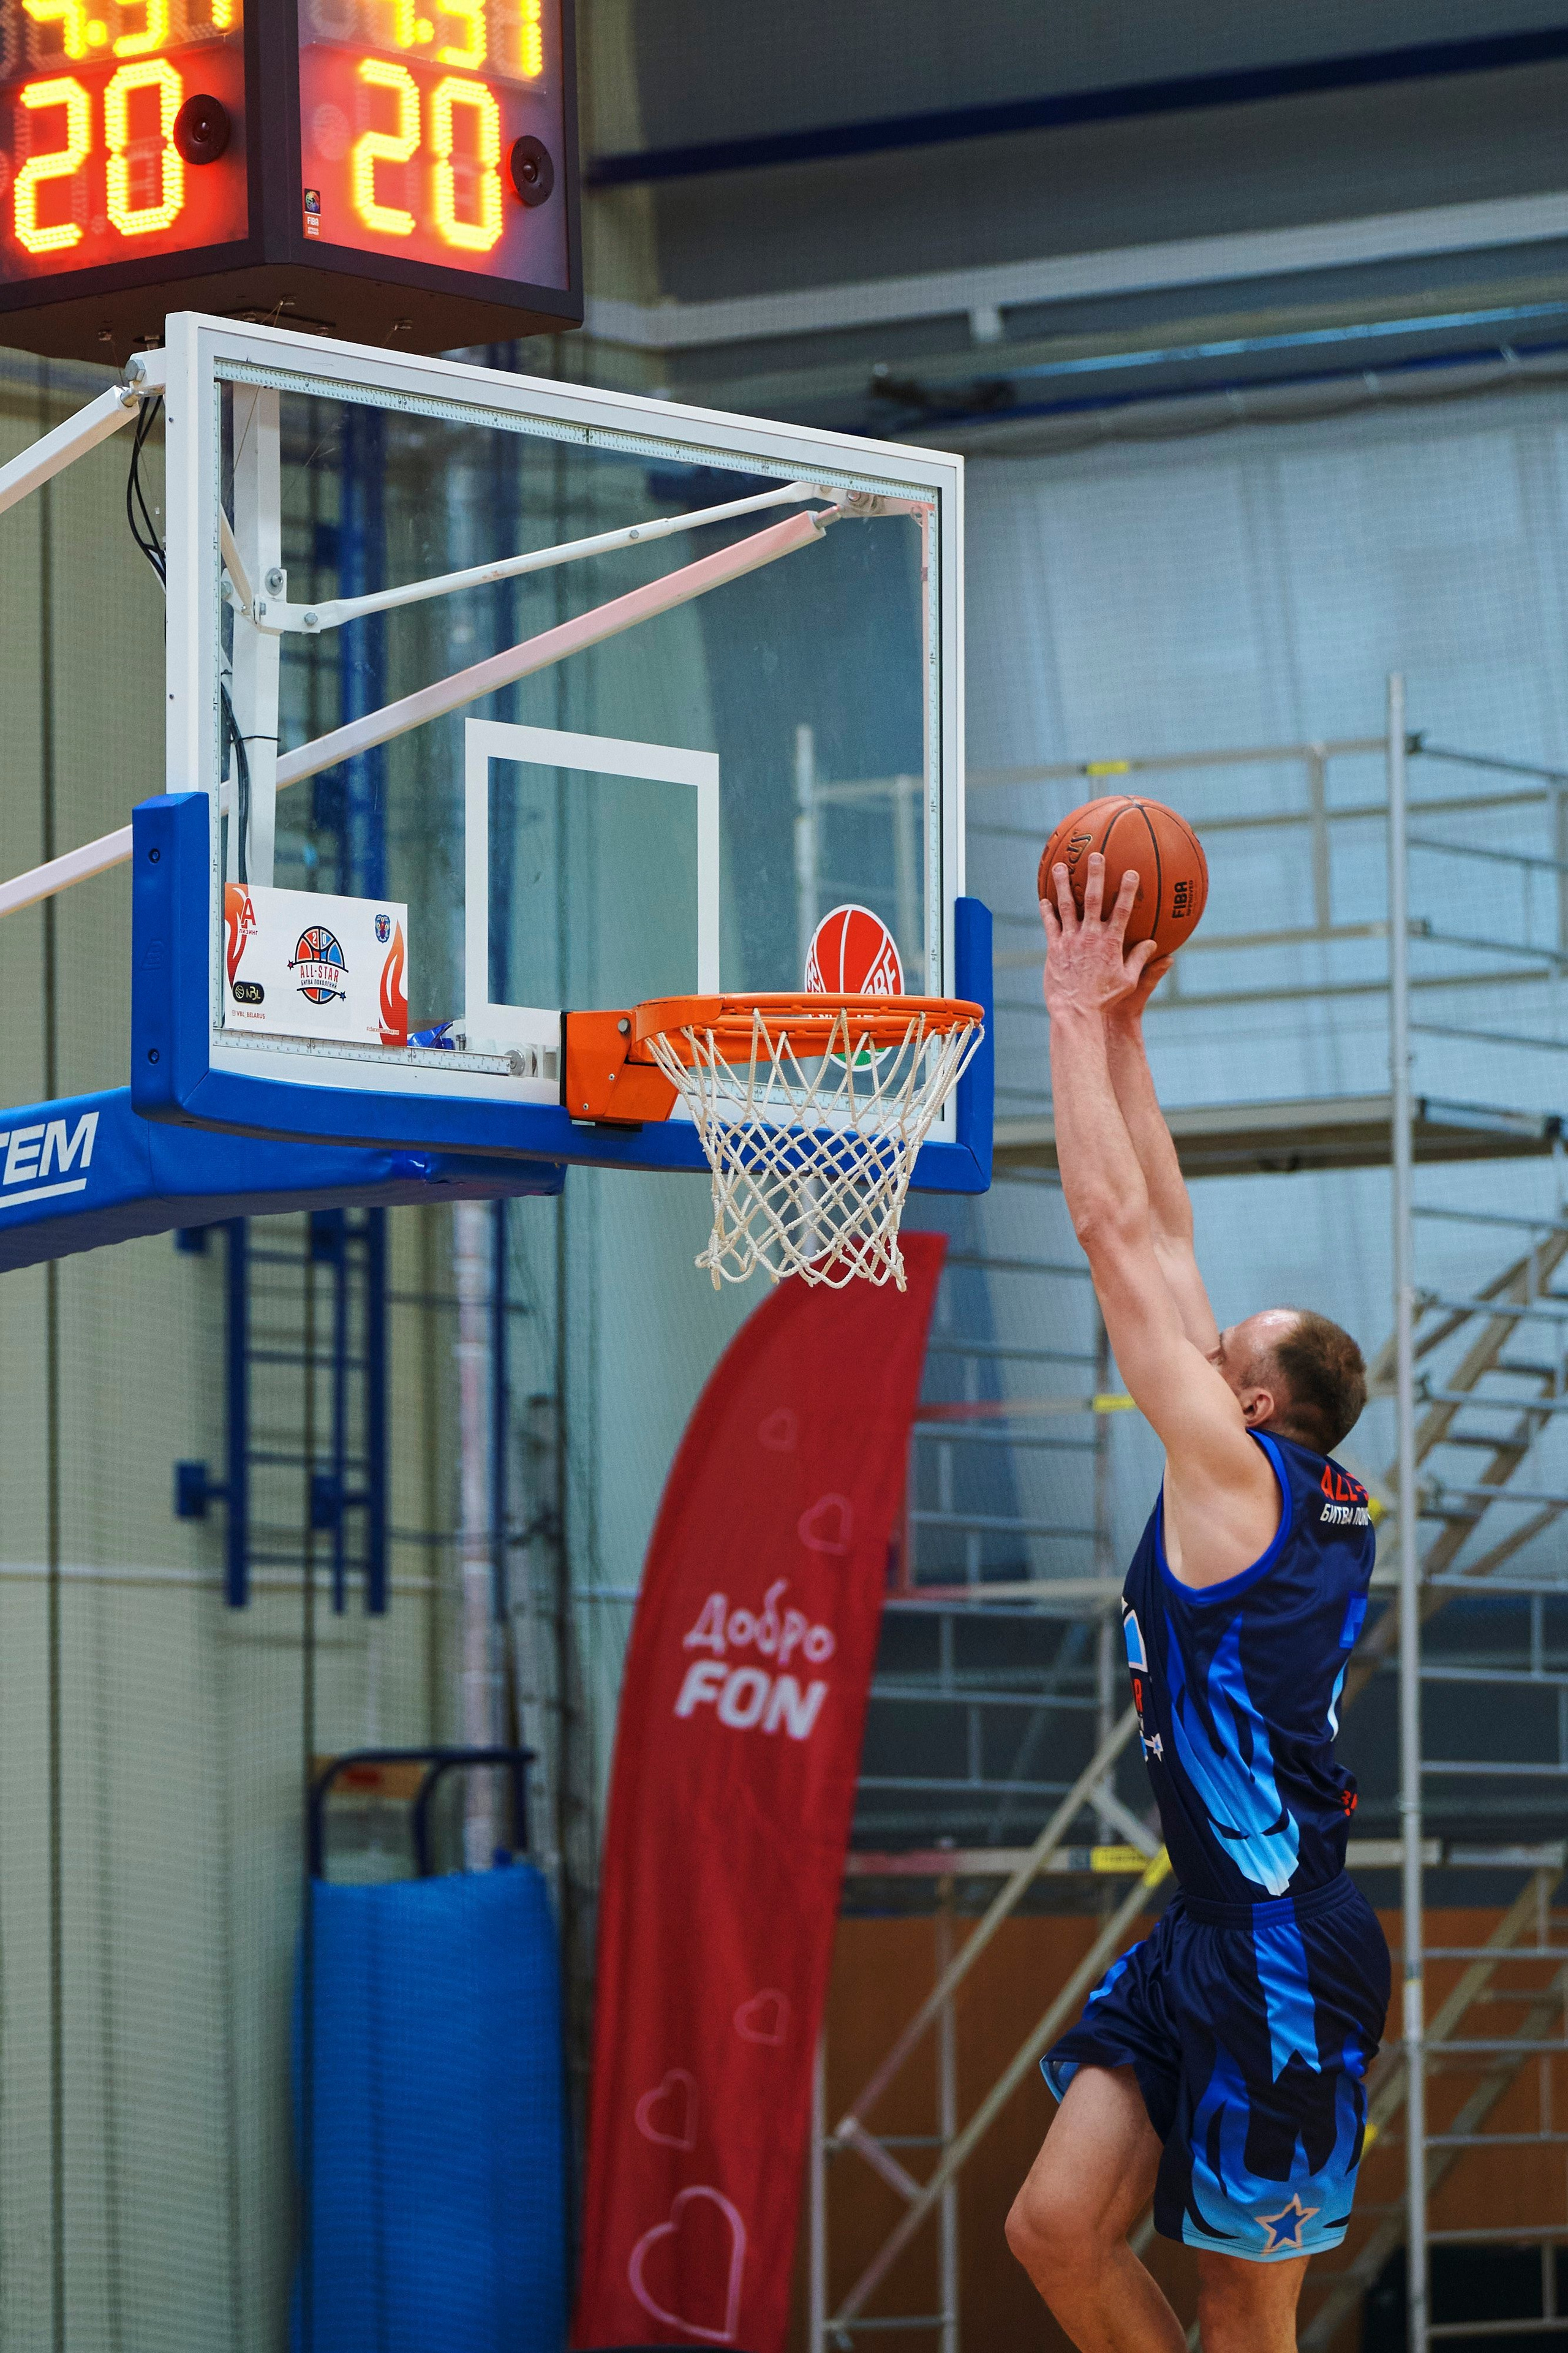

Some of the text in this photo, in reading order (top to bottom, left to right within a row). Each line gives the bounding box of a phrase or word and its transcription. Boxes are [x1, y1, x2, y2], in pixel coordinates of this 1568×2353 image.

[13, 58, 185, 254] 20
[351, 58, 502, 252] 20
[307, 216, 319, 227] FIBA
[1172, 882, 1187, 918] FIBA
[300, 964, 339, 983] ALL-STAR
[314, 979, 337, 989] ПОКОЛЕНИЙ
[1320, 1503, 1353, 1525] БИТВА
[674, 1660, 829, 1740] FON
